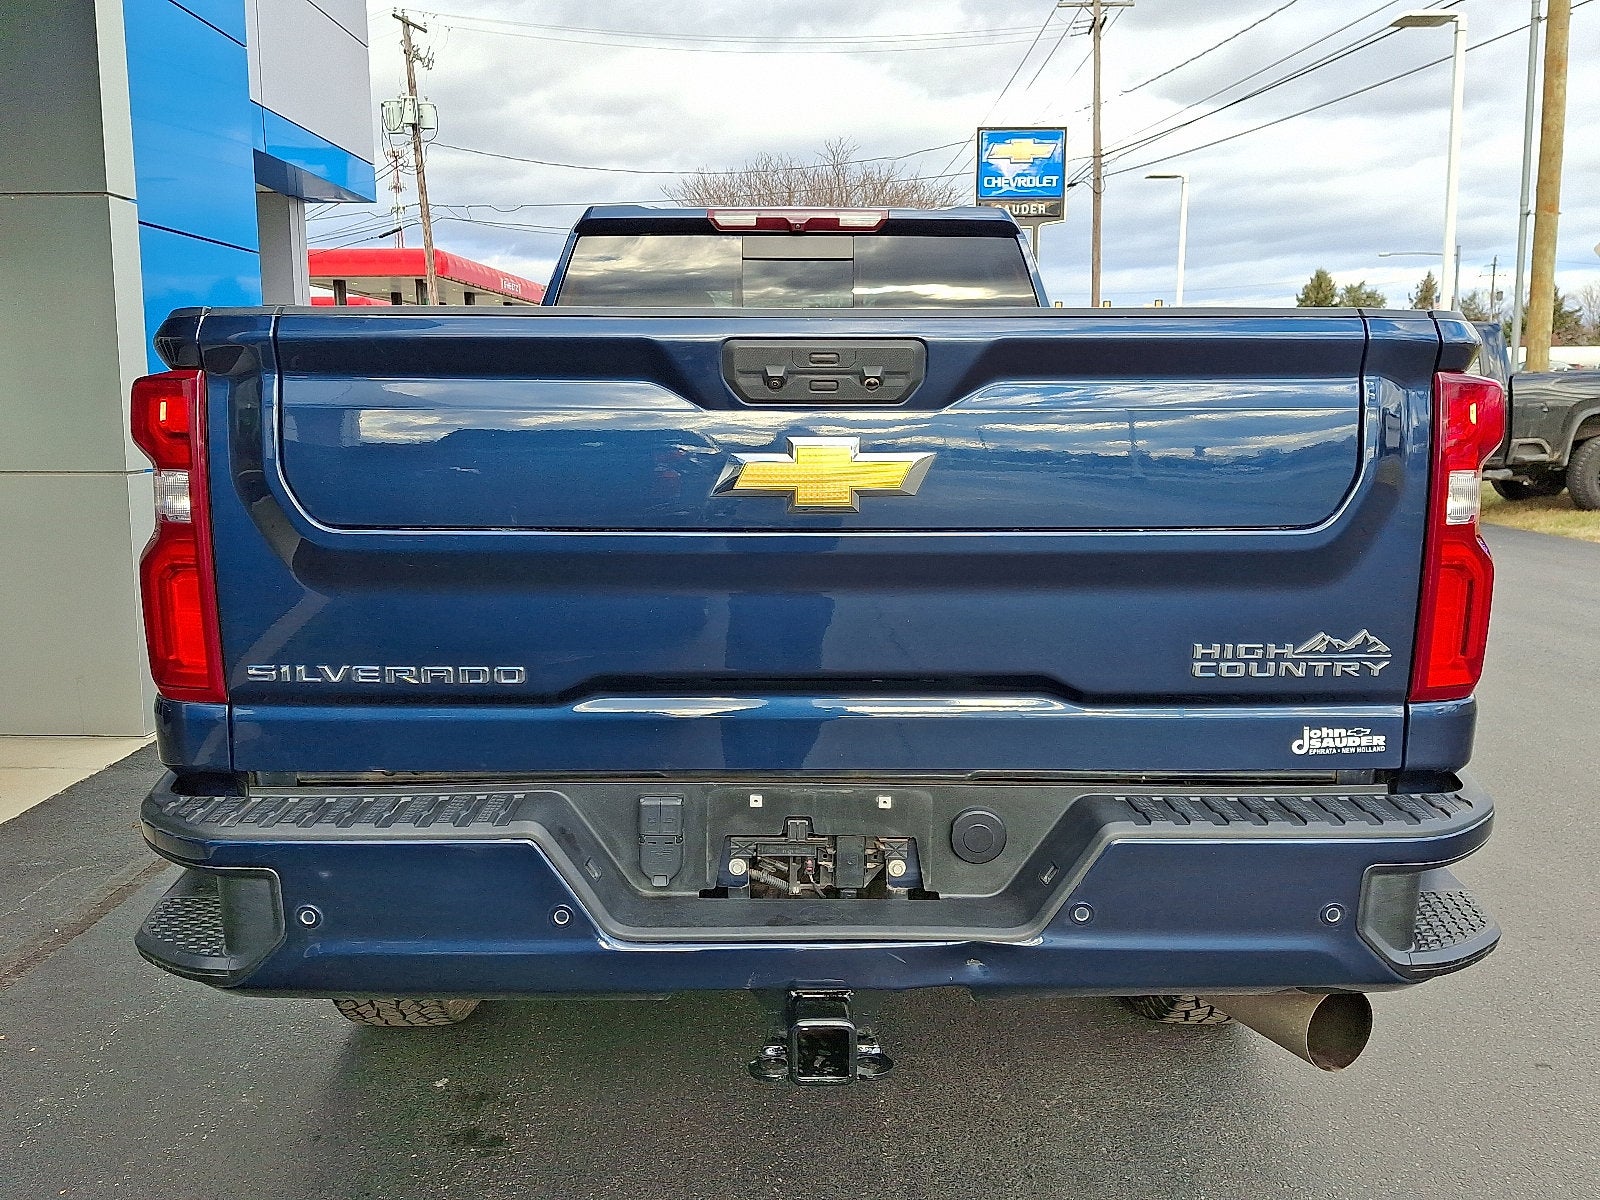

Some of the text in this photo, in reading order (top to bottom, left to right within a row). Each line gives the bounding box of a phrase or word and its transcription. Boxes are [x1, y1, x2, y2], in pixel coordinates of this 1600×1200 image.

[983, 175, 1060, 188] CHEVROLET
[1192, 643, 1295, 659] HIGH
[246, 664, 527, 684] SILVERADO
[1191, 660, 1391, 678] COUNTRY
[1309, 735, 1386, 749] SAUDER
[1341, 746, 1356, 754] NEW
[1357, 745, 1386, 753] HOLLAND
